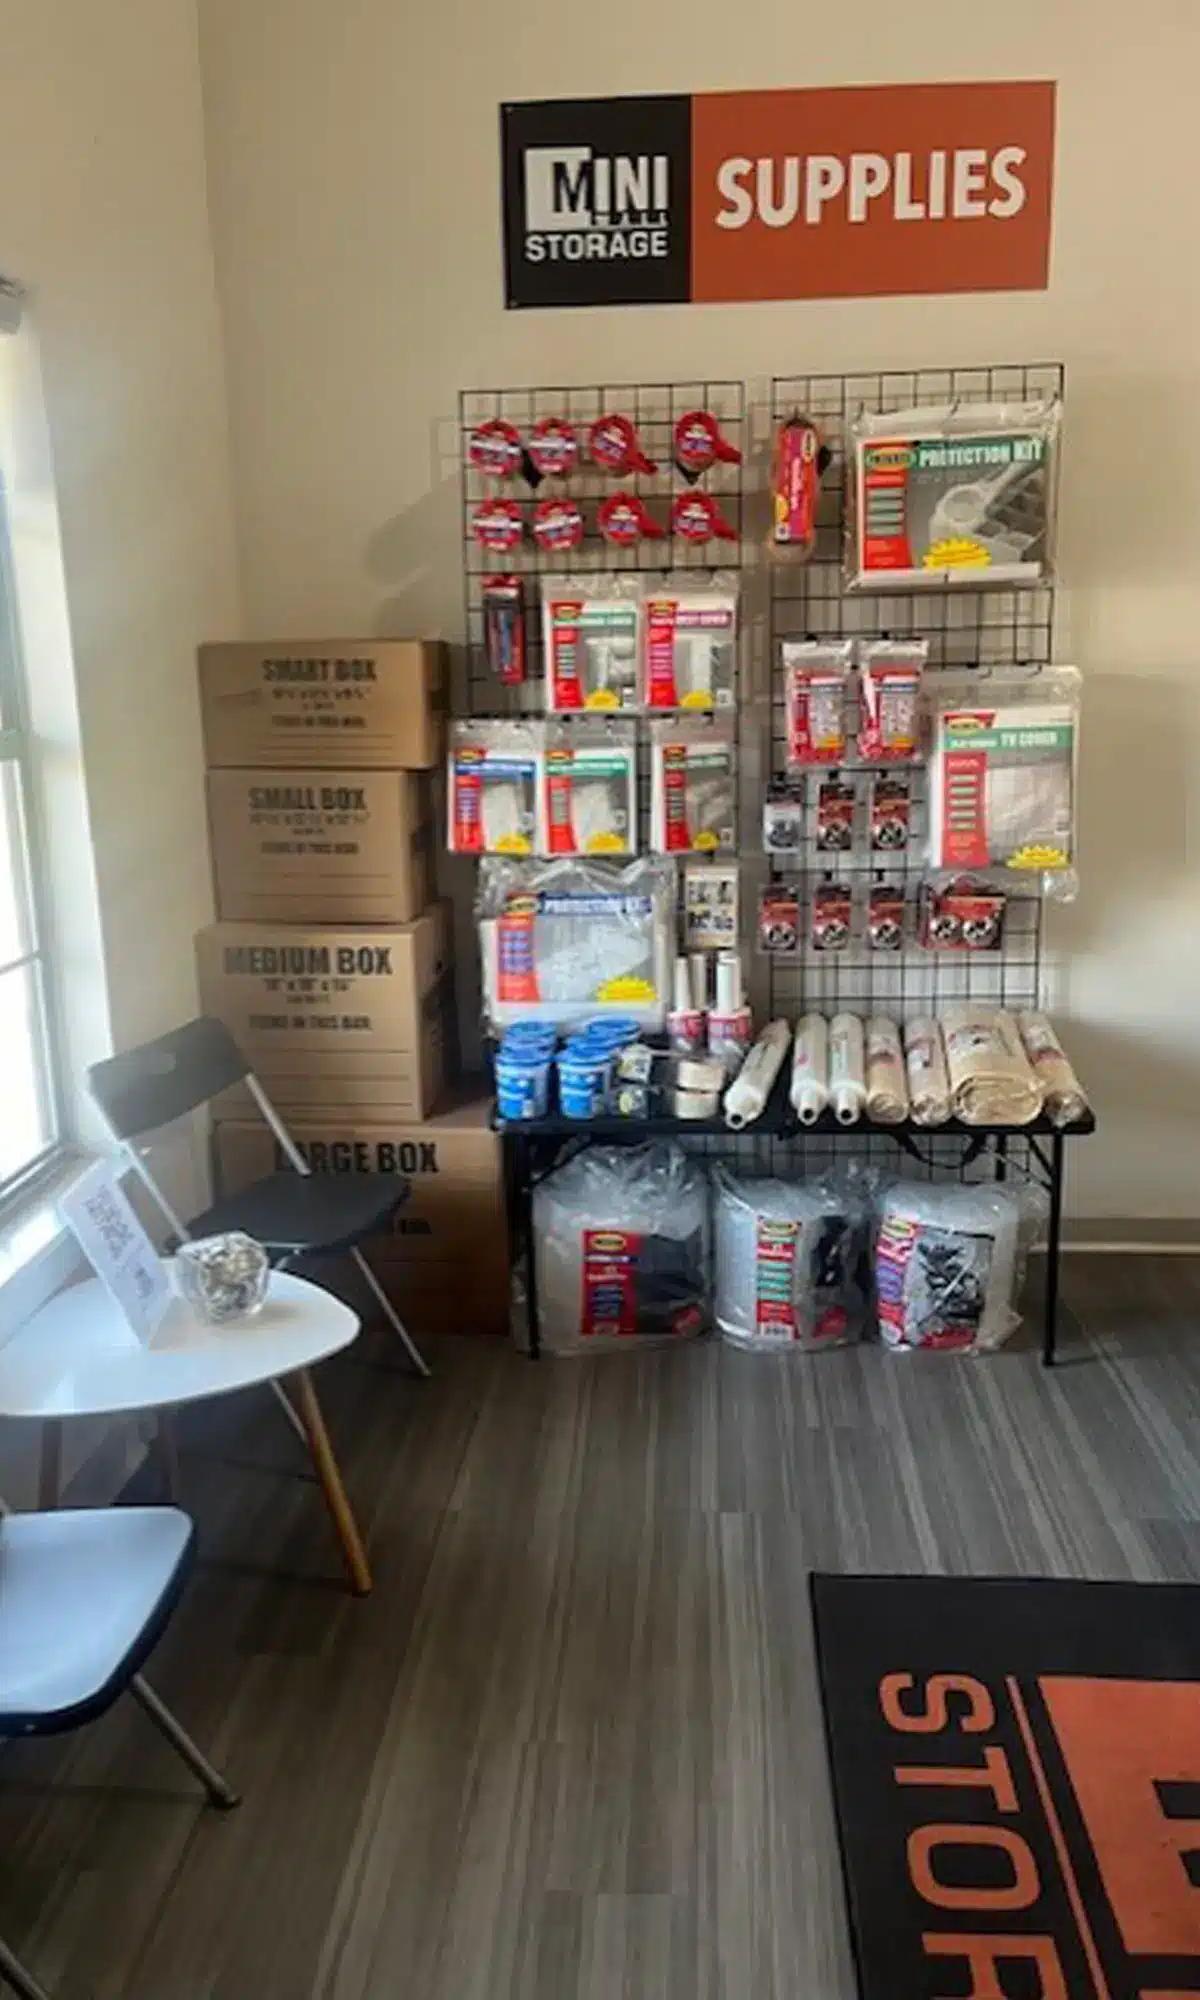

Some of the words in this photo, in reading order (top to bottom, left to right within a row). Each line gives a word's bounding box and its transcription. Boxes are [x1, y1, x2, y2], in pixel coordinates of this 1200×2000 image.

[553, 156, 668, 213] MINI
[715, 146, 1026, 229] SUPPLIES
[525, 231, 668, 262] STORAGE
[335, 658, 377, 680] BOX
[250, 787, 316, 809] SMALL
[321, 787, 367, 809] BOX
[224, 946, 330, 974] MEDIUM
[336, 946, 393, 975] BOX
[375, 1141, 440, 1174] BOX
